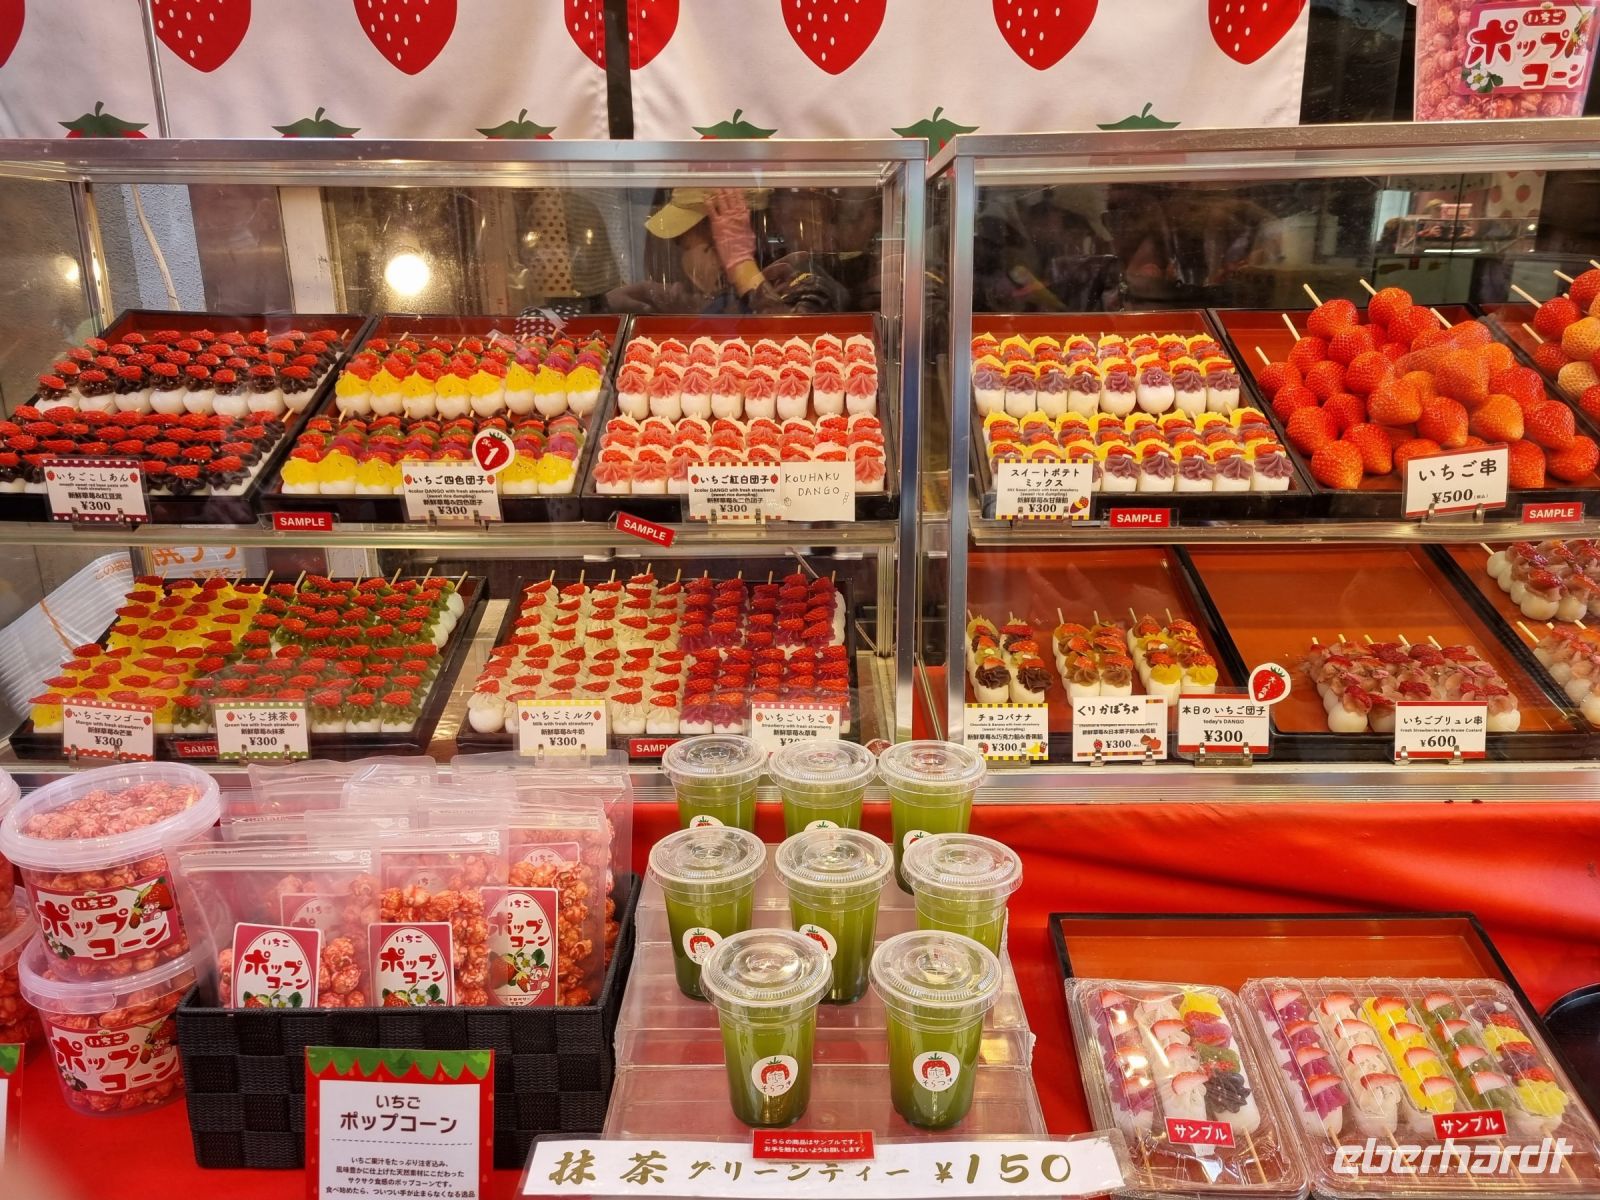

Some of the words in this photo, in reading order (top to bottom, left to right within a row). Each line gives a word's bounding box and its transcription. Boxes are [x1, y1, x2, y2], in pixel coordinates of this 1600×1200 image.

[1527, 12, 1563, 23] いちご
[1468, 19, 1571, 65] ポップ
[1522, 63, 1585, 87] コーン
[484, 447, 499, 465] 1
[1010, 468, 1079, 478] スイートポテト
[1419, 458, 1497, 482] いちご串
[57, 472, 128, 482] いちごこしあん
[413, 475, 486, 485] いちご四色団子
[700, 474, 770, 485] いちご紅白団子
[785, 472, 840, 483] KOUHAKU
[1025, 479, 1063, 487] ミックス
[798, 487, 840, 497] DANGO
[1432, 488, 1473, 504] ¥500
[80, 501, 111, 510] ¥300
[437, 506, 467, 515] ¥300
[720, 504, 748, 513] ¥300
[1029, 504, 1057, 513] ¥300
[1117, 514, 1162, 523] SAMPLE
[1529, 508, 1574, 519] SAMPLE
[280, 517, 325, 526] SAMPLE
[623, 519, 667, 541] SAMPLE
[72, 711, 142, 722] いちごマンゴー
[237, 711, 289, 721] いちご抹茶
[530, 711, 592, 720] いちごミルク
[764, 713, 827, 723] いちごいちご
[978, 713, 1032, 721] チョコバナナ
[1403, 715, 1483, 726] いちごブリュレ串
[94, 736, 123, 746] ¥300
[249, 736, 277, 746] ¥300
[550, 736, 577, 746] ¥300
[1204, 730, 1243, 742] ¥300
[1420, 735, 1457, 748] ¥600
[991, 743, 1018, 752] ¥300
[1105, 740, 1131, 748] ¥300
[76, 896, 113, 909] いちご
[37, 900, 129, 938] ポップ
[488, 912, 543, 937] ポップ
[88, 923, 167, 957] コーン
[262, 938, 290, 948] いちご
[396, 934, 423, 944] いちご
[510, 936, 550, 948] コーン
[244, 949, 303, 976] ポップ
[380, 947, 437, 973] ポップ
[266, 976, 309, 990] コーン
[403, 971, 445, 984] コーン
[89, 1034, 125, 1047] いちご
[52, 1036, 140, 1073] ポップ
[100, 1056, 177, 1092] コーン
[376, 1095, 421, 1110] いちご
[340, 1111, 458, 1134] ポップコーン
[1441, 1116, 1499, 1134] サンプル
[1174, 1124, 1227, 1140] サンプル
[549, 1149, 668, 1185] 抹茶
[688, 1159, 910, 1183] グリーンティー
[934, 1153, 1071, 1185] ¥150
